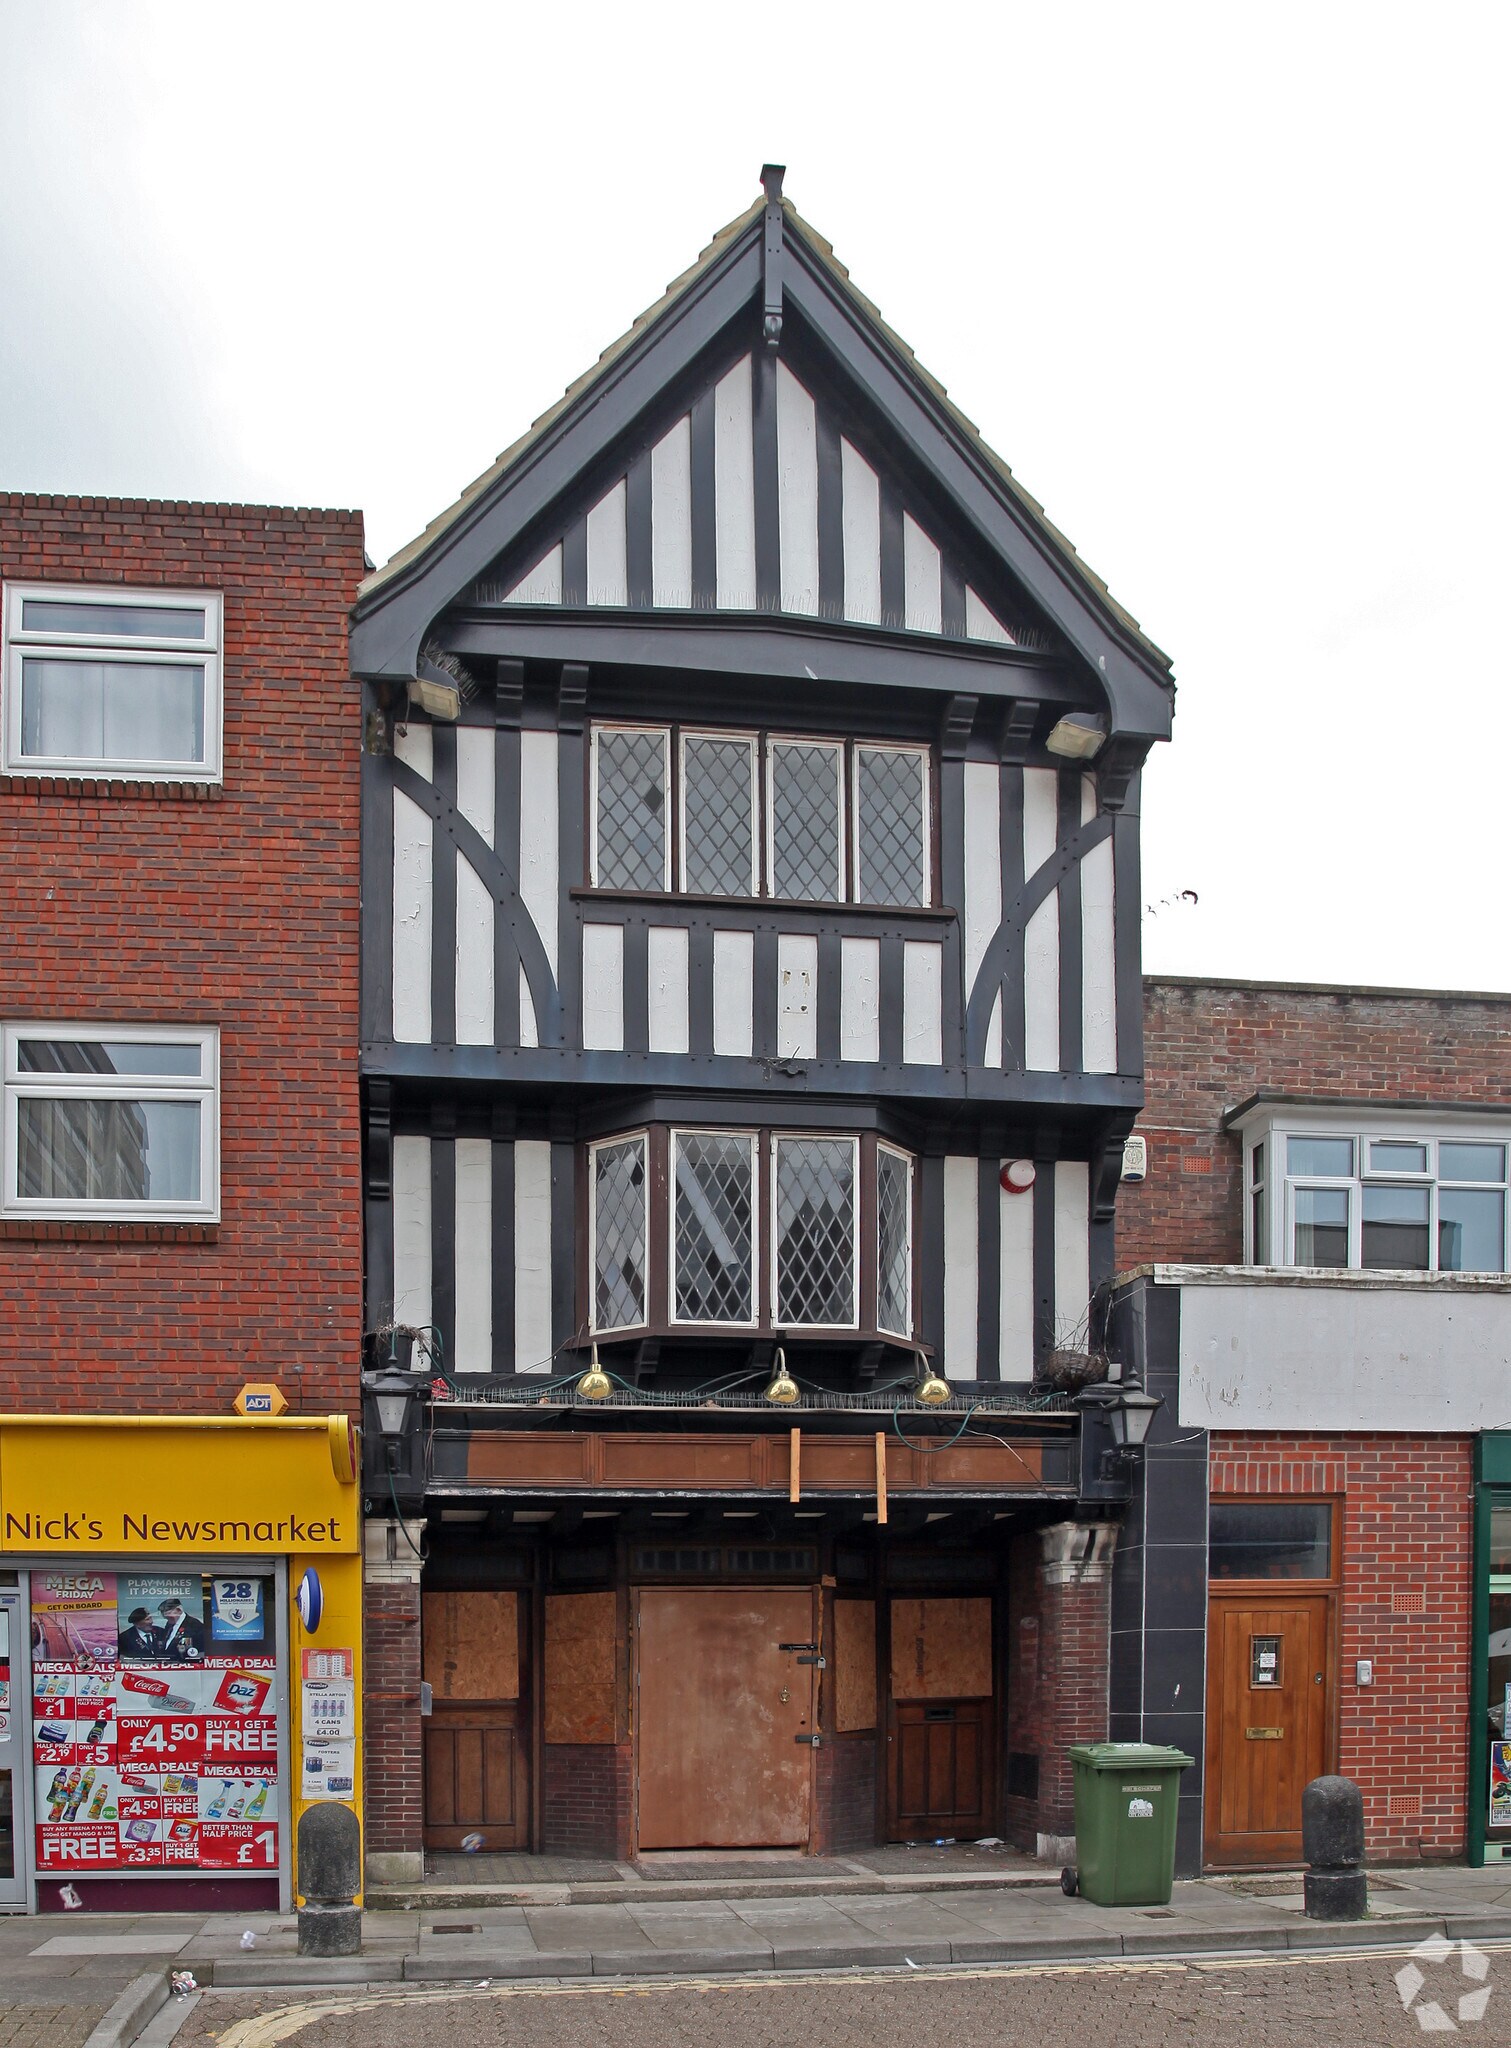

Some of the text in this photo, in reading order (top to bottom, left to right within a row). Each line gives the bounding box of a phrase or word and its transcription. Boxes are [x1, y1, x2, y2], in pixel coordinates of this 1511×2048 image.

[246, 1398, 271, 1408] ADT
[5, 1512, 342, 1542] Nick's Newsmarket
[46, 1576, 104, 1591] MEGA
[222, 1582, 252, 1598] 28
[55, 1591, 94, 1599] FRIDAY
[34, 1662, 73, 1672] MEGA
[204, 1658, 276, 1668] MEGA DEAL
[228, 1684, 256, 1697] Daz
[46, 1698, 65, 1716] £1
[98, 1702, 116, 1720] £1
[121, 1719, 151, 1728] ONLY
[206, 1720, 230, 1728] BUY
[234, 1720, 240, 1728] 1
[244, 1720, 268, 1728] GET
[130, 1723, 198, 1752] £4.50
[206, 1730, 277, 1750] FREE
[40, 1748, 70, 1762] £2.19
[86, 1746, 110, 1764] £5
[120, 1762, 198, 1772] MEGA DEALS
[204, 1766, 277, 1776] MEGA DEAL
[122, 1800, 158, 1816] £4.50
[164, 1802, 198, 1814] FREE
[42, 1838, 117, 1860] FREE
[237, 1830, 274, 1863] £1
[128, 1848, 160, 1862] £3.35
